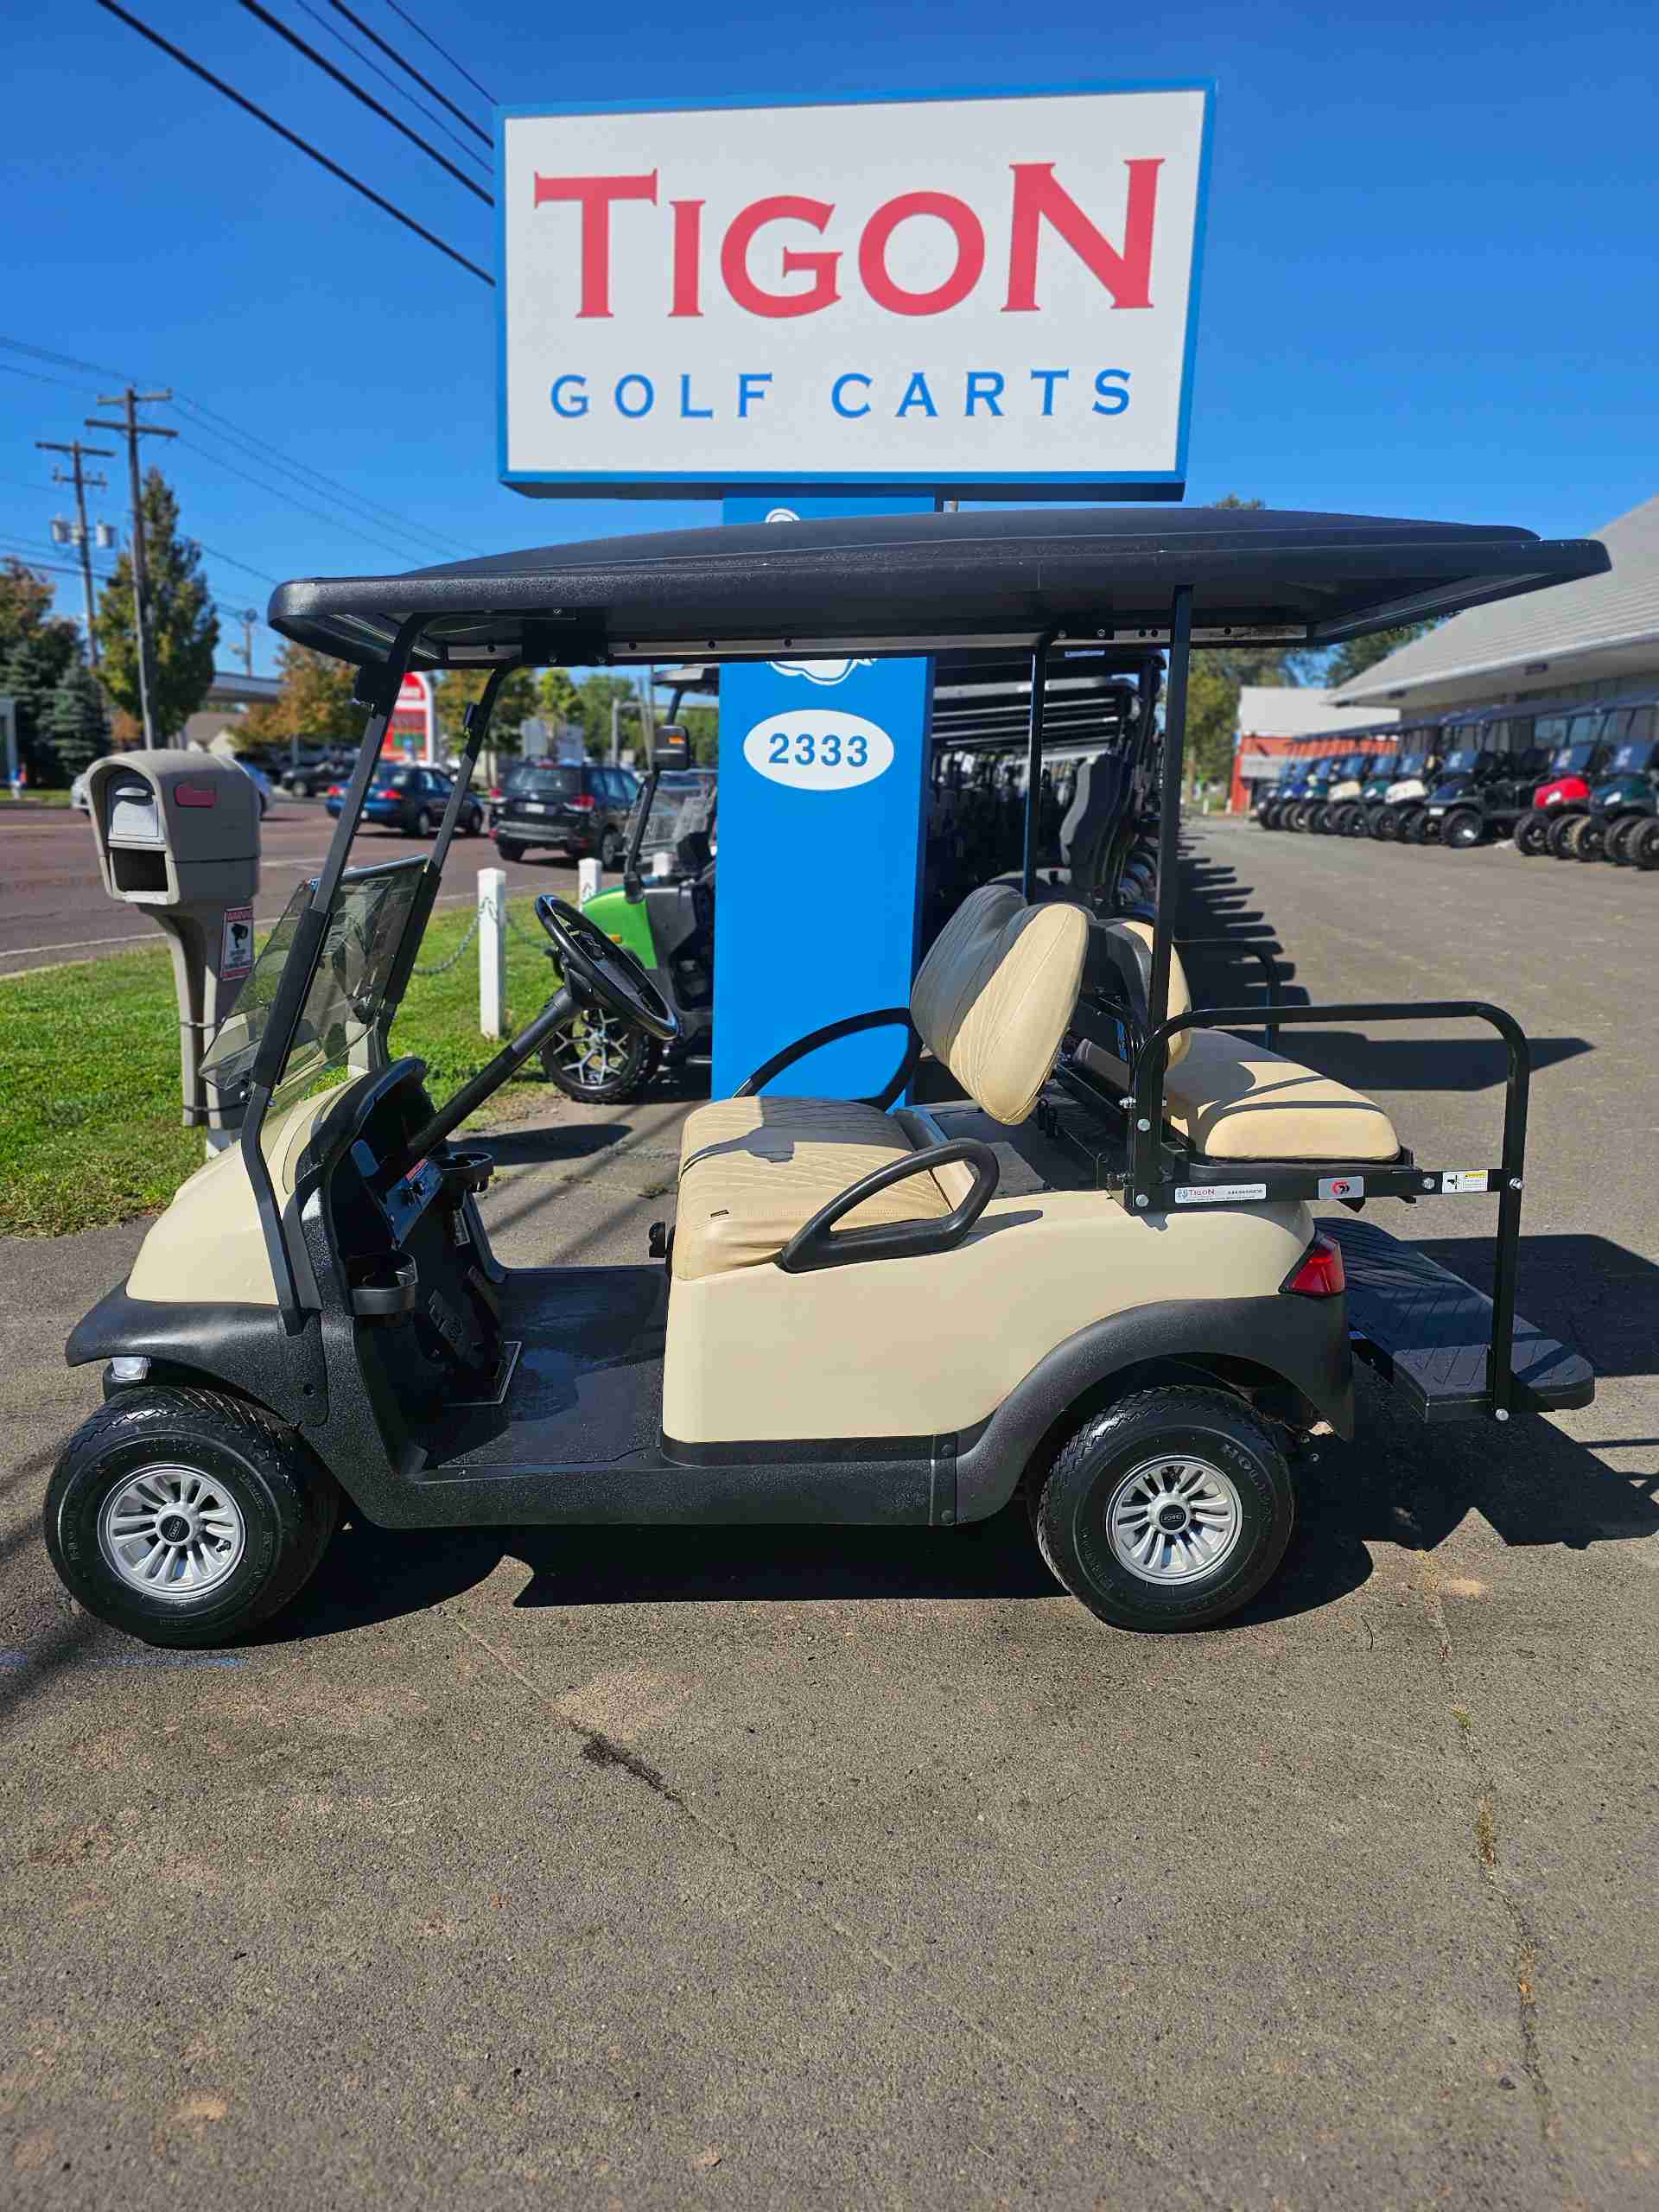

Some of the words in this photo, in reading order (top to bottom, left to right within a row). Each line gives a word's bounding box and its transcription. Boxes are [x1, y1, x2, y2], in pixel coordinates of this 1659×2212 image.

[534, 158, 1165, 318] TIGON
[550, 372, 773, 419] GOLF
[830, 368, 1131, 419] CARTS
[769, 733, 868, 767] 2333
